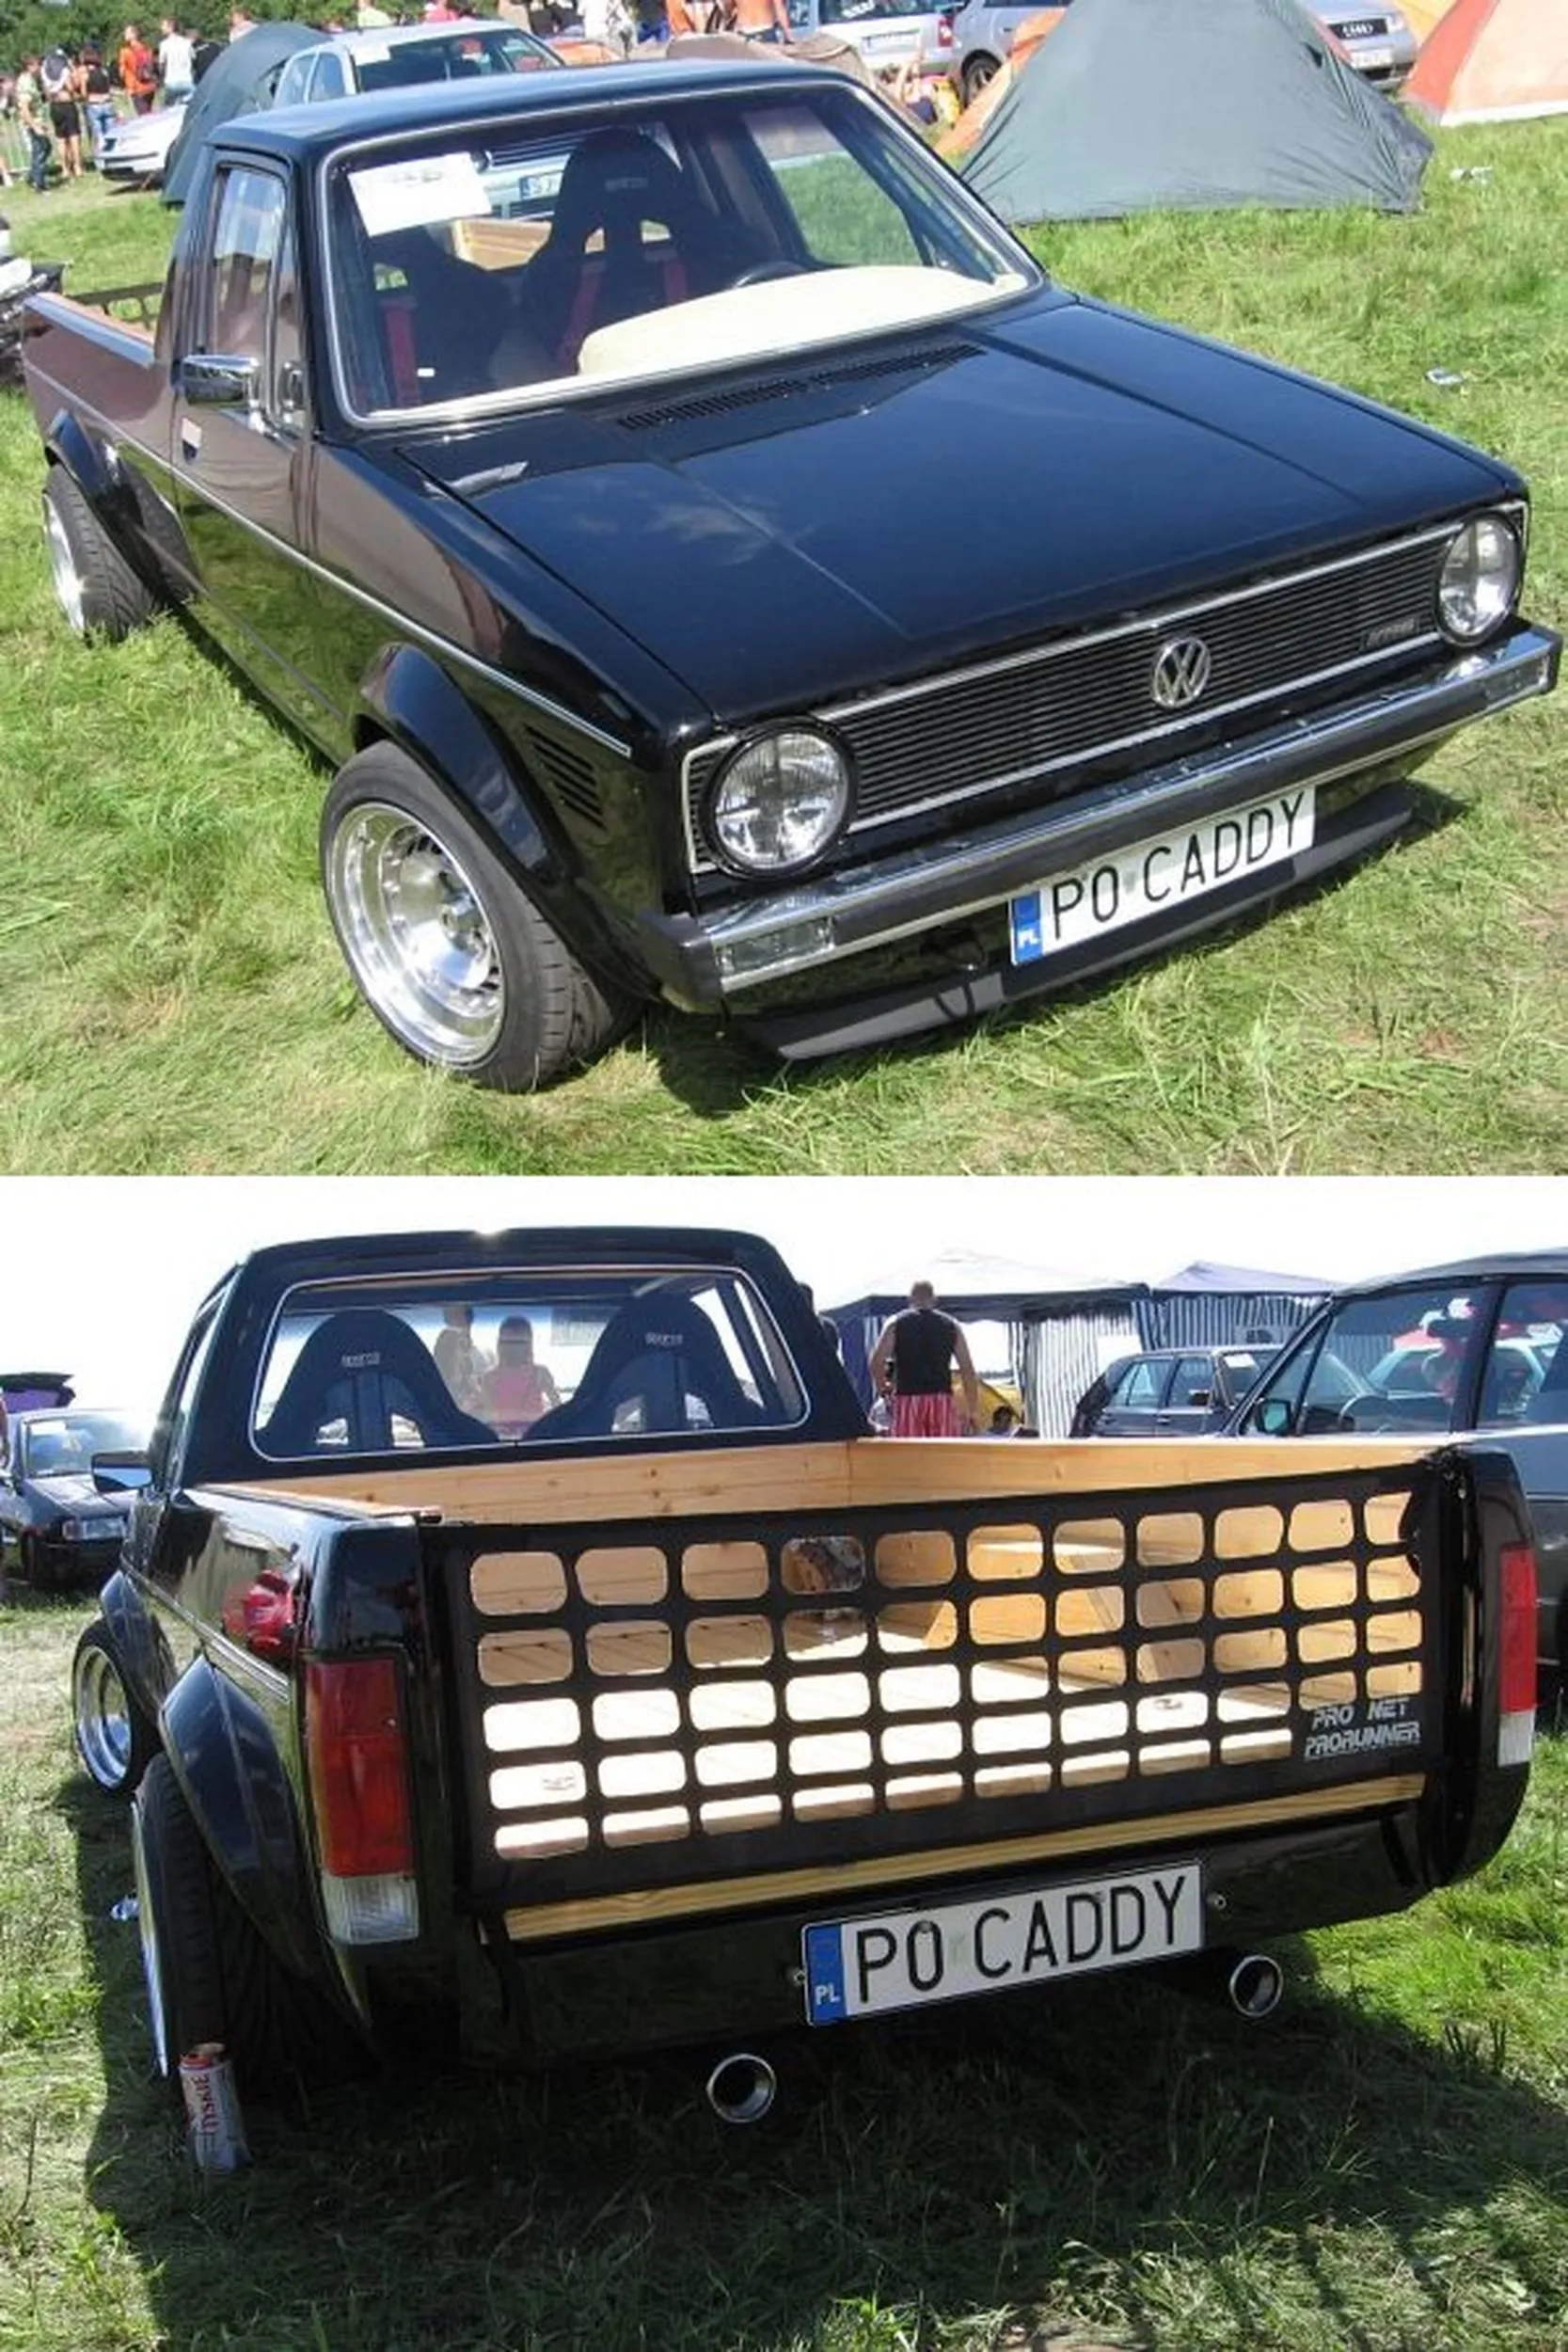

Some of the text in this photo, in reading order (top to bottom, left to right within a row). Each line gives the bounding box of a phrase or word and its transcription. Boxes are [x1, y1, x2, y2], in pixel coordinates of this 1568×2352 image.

[1052, 790, 1305, 941] PO CADDY
[1311, 1696, 1410, 1731] PRO NET
[1304, 1721, 1422, 1757] PRORUNNER
[855, 1874, 1186, 2004] PO CADDY
[815, 1984, 841, 2006] PL
